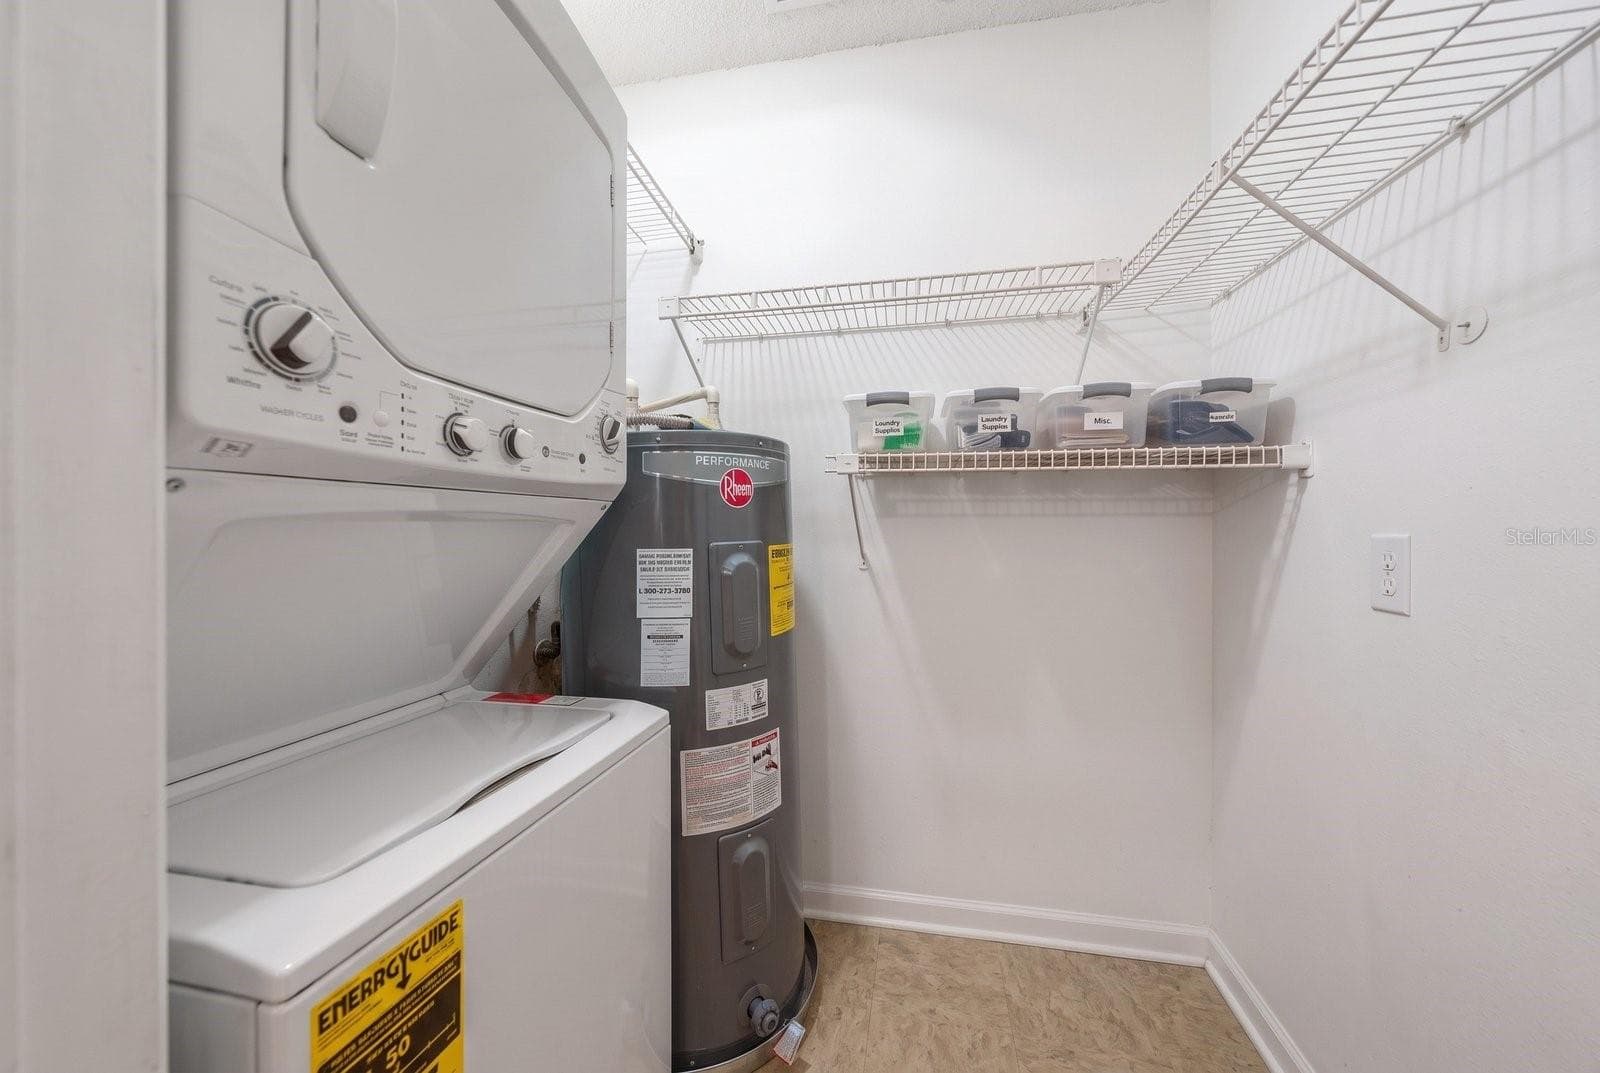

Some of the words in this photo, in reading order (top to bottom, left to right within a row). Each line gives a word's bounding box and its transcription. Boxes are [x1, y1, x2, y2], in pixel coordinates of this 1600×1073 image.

[1094, 417, 1112, 425] Misc.
[695, 455, 770, 470] PERFORMANCE
[724, 470, 752, 502] Rheem
[386, 1034, 411, 1070] 50
